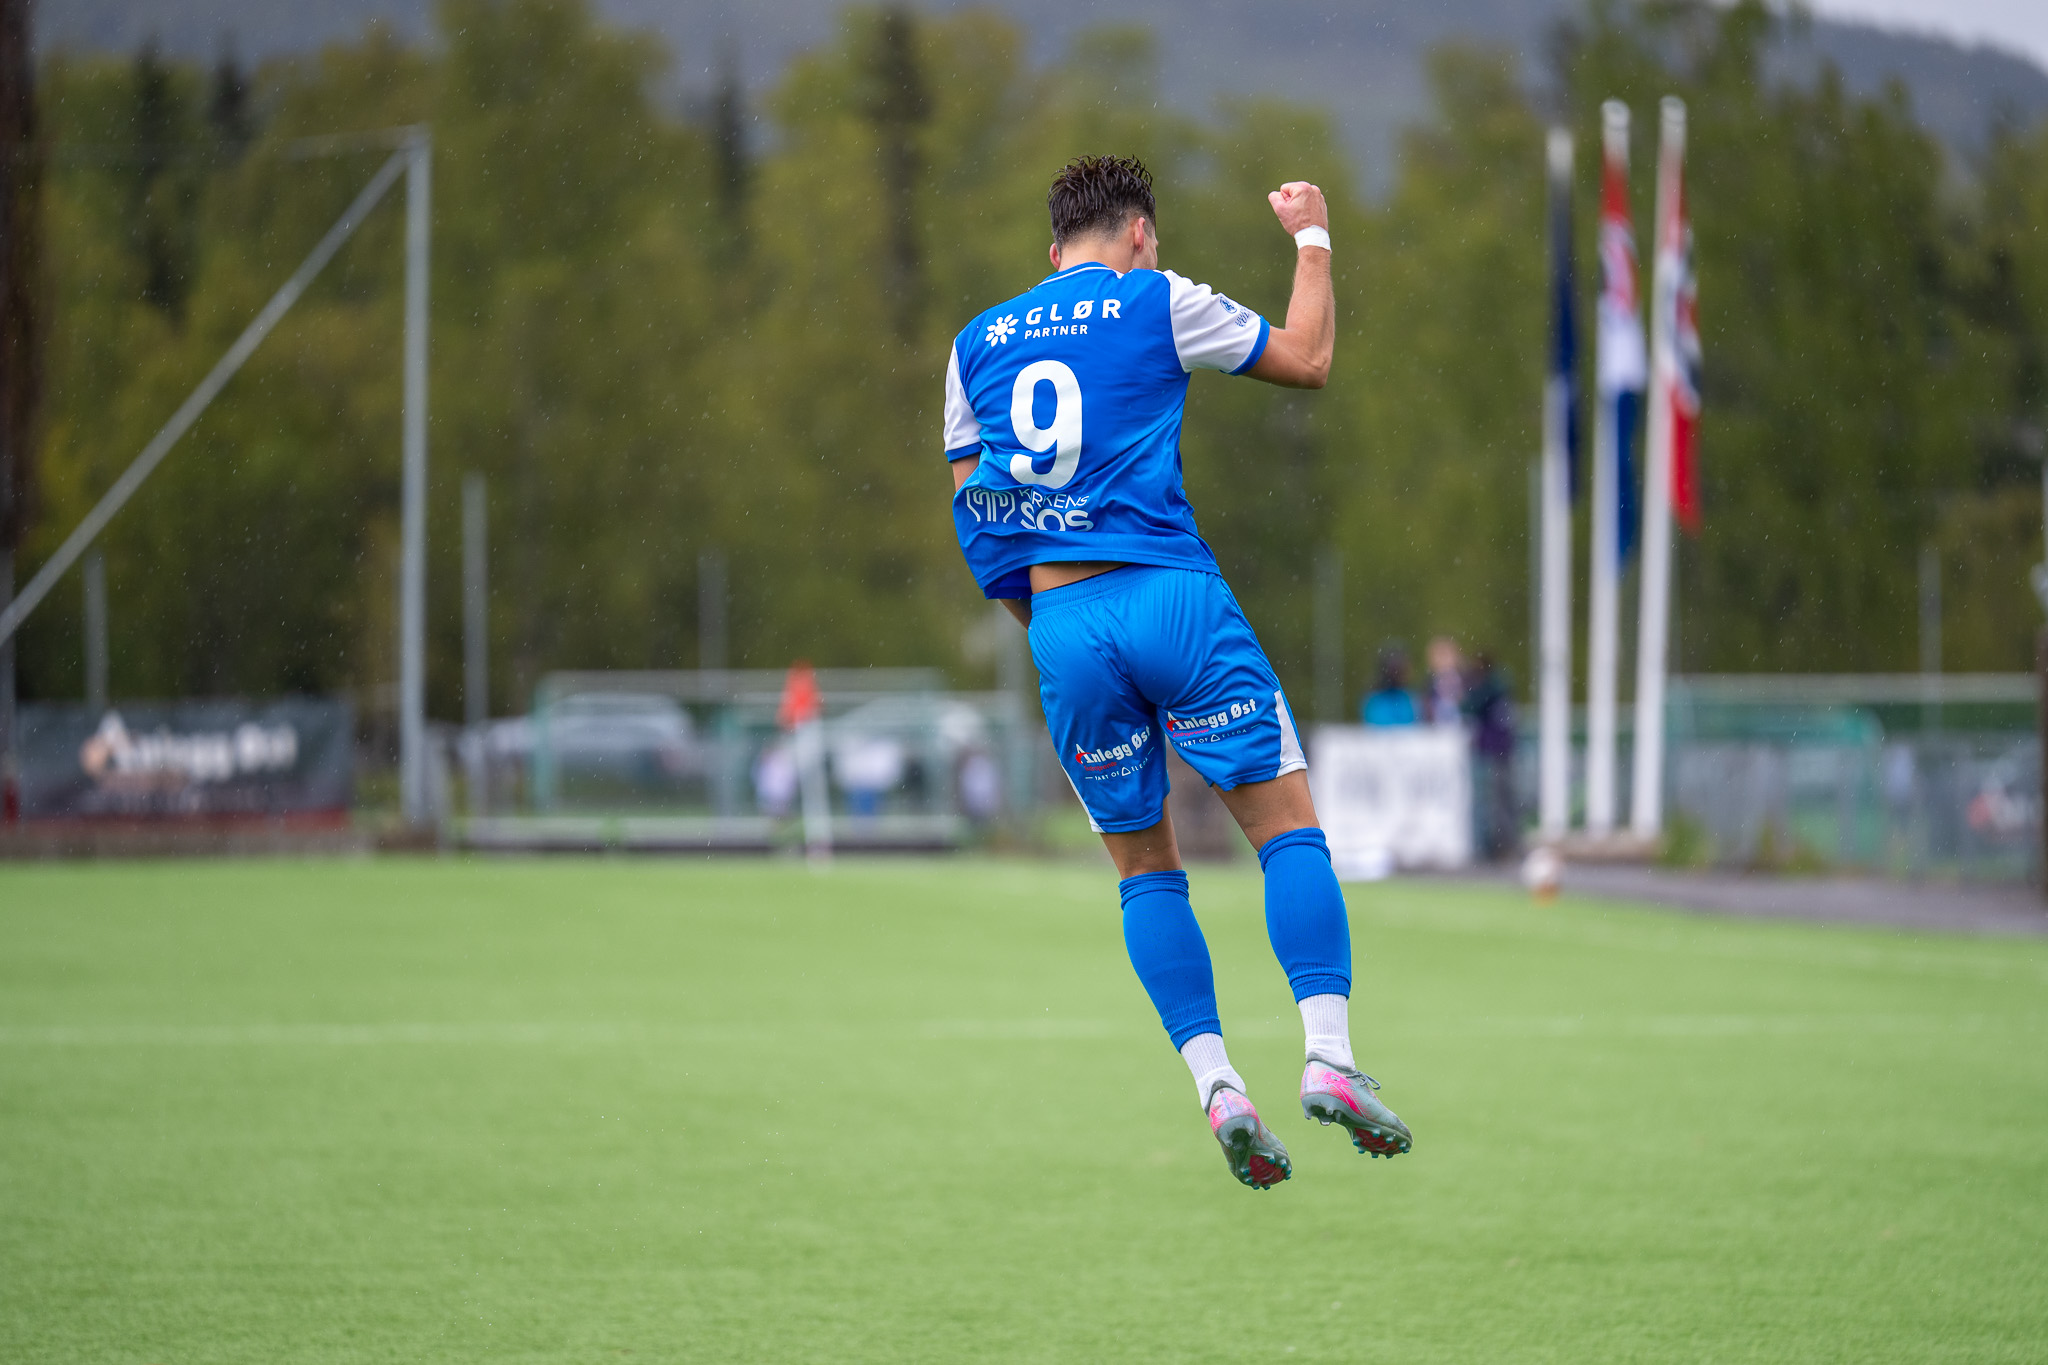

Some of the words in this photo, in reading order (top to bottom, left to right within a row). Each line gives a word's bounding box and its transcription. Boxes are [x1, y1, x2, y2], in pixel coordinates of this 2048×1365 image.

[1025, 299, 1121, 325] GLØR
[1024, 324, 1088, 340] PARTNER
[1009, 359, 1083, 490] 9
[1020, 501, 1094, 532] SOS
[1166, 711, 1229, 732] Anlegg
[1230, 698, 1257, 720] Øst
[1075, 743, 1133, 765] Anlegg
[1131, 725, 1151, 750] Øst
[1179, 739, 1196, 748] PART
